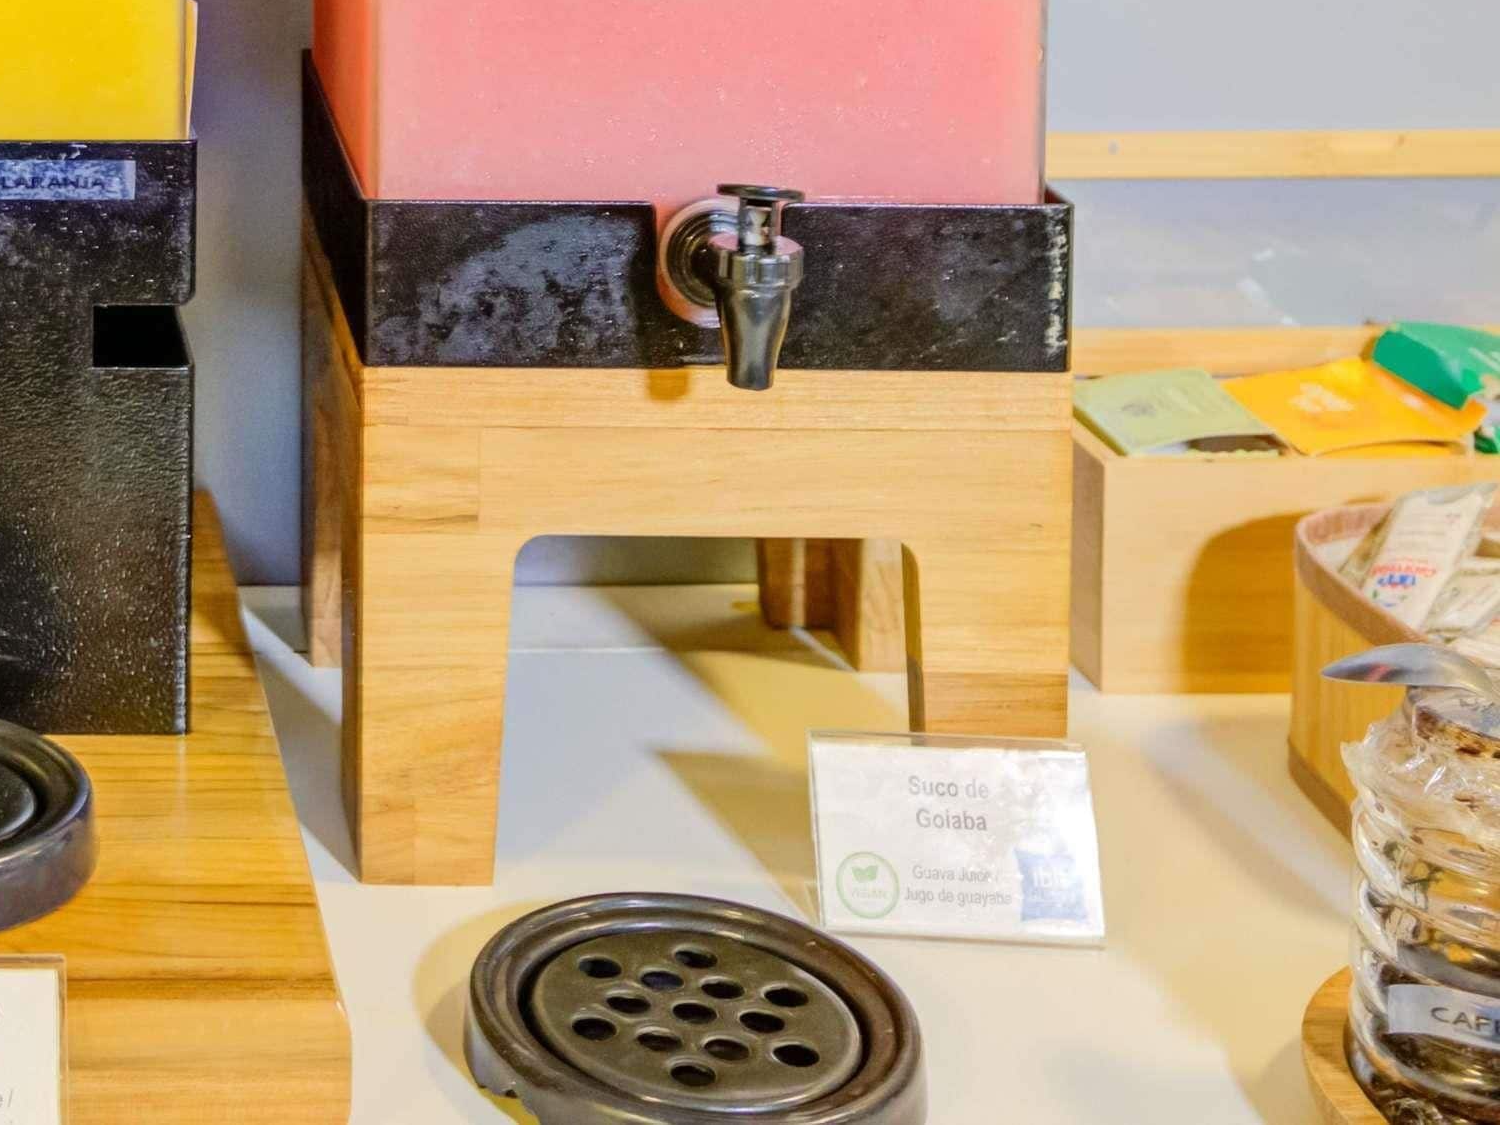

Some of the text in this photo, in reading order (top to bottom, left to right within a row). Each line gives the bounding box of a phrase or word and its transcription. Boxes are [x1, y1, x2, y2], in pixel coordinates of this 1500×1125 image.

[0, 175, 106, 190] LARANJA
[907, 775, 989, 799] Suco de
[915, 807, 988, 831] Goiaba
[911, 864, 955, 882] Guava
[904, 886, 934, 904] Jugo
[938, 887, 954, 903] de
[1430, 1006, 1500, 1036] CAF
